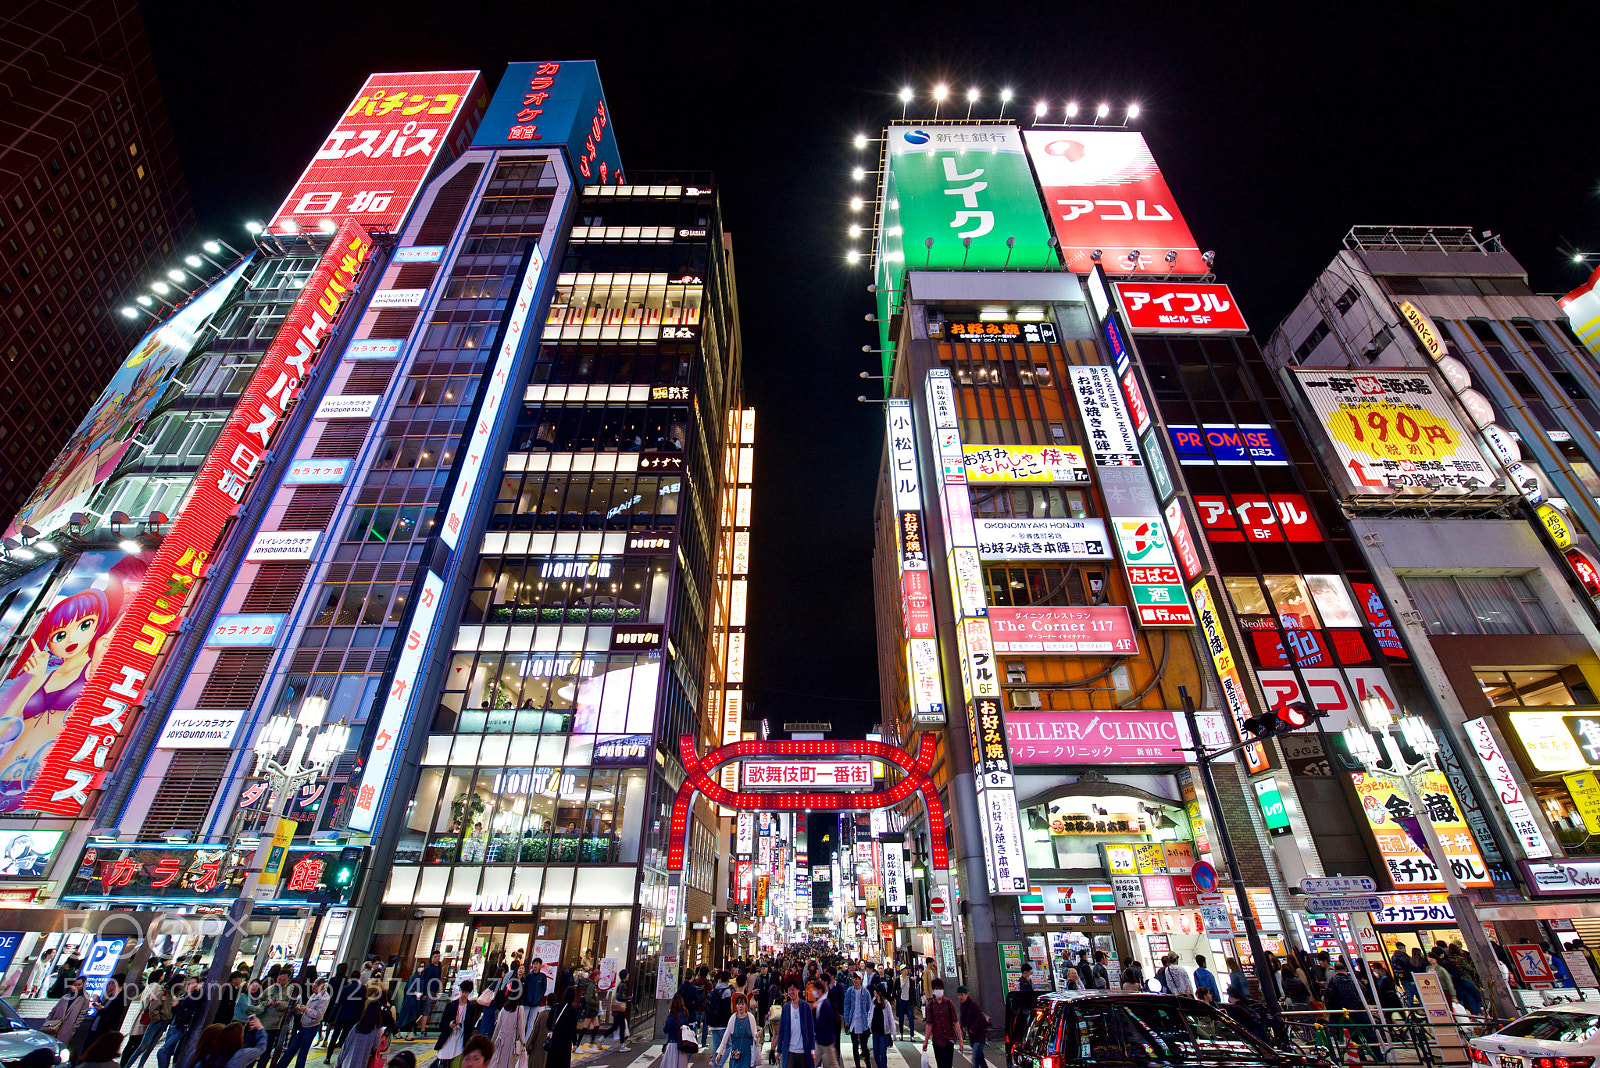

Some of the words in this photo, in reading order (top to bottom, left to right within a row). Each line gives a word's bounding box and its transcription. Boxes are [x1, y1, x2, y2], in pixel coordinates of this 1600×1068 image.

[346, 90, 459, 117] パチンコ
[507, 62, 560, 140] カラオケ館
[319, 121, 439, 159] エスパス
[936, 132, 1007, 143] 新生銀行
[293, 190, 395, 213] 日拓
[942, 157, 995, 239] レイク
[1057, 199, 1173, 221] アコム
[318, 236, 369, 317] パチンコ
[1123, 292, 1230, 313] アイフル
[1158, 315, 1189, 324] 当ビル
[1191, 315, 1211, 324] 5F
[951, 323, 1020, 335] お好み焼
[245, 308, 329, 449] エスパス
[1305, 376, 1432, 395] 一軒め酒場
[1077, 376, 1112, 451] お好み焼き本陣
[1101, 368, 1122, 419] OKONOMIYAKI
[1118, 420, 1135, 452] HONJIN
[1346, 411, 1451, 444] 190円
[1176, 432, 1272, 447] PROMISE
[894, 416, 916, 494] 小松ビル
[964, 448, 1008, 466] お好み
[979, 453, 1033, 475] もんじゃ
[1041, 449, 1079, 466] 焼き
[291, 467, 343, 475] カラオケ館
[1011, 463, 1043, 479] たこ
[1198, 502, 1307, 525] アイフル
[904, 512, 921, 552] お好み焼
[1254, 529, 1272, 539] 5F
[630, 538, 670, 549] DOUTOR
[980, 542, 1071, 554] お好み焼き本陣
[541, 561, 612, 578] DOUTOR
[1130, 568, 1178, 582] たばこ
[133, 547, 209, 656] パチンコ
[1148, 588, 1171, 603] 酒
[1015, 612, 1091, 620] ダイニングレストラン
[1142, 608, 1191, 621] 銀行ATM
[215, 625, 275, 635] カラオケ館
[914, 623, 929, 633] 4F
[995, 620, 1026, 632] The
[1032, 620, 1085, 632] Corner
[1091, 620, 1113, 632] 117
[1201, 609, 1225, 657] 金の蔵
[1240, 619, 1276, 629] Neolive
[616, 632, 659, 644] DOUTOR
[1116, 638, 1132, 650] 4F
[519, 657, 595, 677] DOUTOR
[973, 652, 993, 681] ブル
[1219, 656, 1230, 670] 2F
[979, 683, 993, 693] 6F
[1262, 678, 1396, 711] アコム
[355, 587, 436, 812] カラオケ館
[51, 665, 147, 807] エスパス
[166, 730, 205, 738] JOYSOUND
[222, 730, 230, 739] 2
[980, 701, 1004, 759] お好み焼
[1007, 722, 1082, 740] FILLER
[1099, 722, 1176, 740] CLINIC
[599, 744, 646, 758] DOUTOR
[1053, 746, 1113, 758] クリニック
[1136, 748, 1163, 756] 新宿院
[492, 771, 575, 795] DOUTOR
[748, 765, 867, 784] 歌舞伎町一番街
[991, 774, 1006, 784] 8F
[290, 812, 317, 821] BAR
[1264, 805, 1283, 815] レイク
[1384, 793, 1460, 824] 金蔵
[1515, 820, 1533, 829] TAX
[991, 800, 1011, 879] お好み焼き本陣
[1380, 836, 1407, 852] 元祖
[107, 859, 324, 892] カラオ館
[1387, 859, 1403, 883] 東京
[1398, 858, 1486, 882] チカめし
[1384, 903, 1455, 921] チカラめし
[86, 946, 107, 971] P
